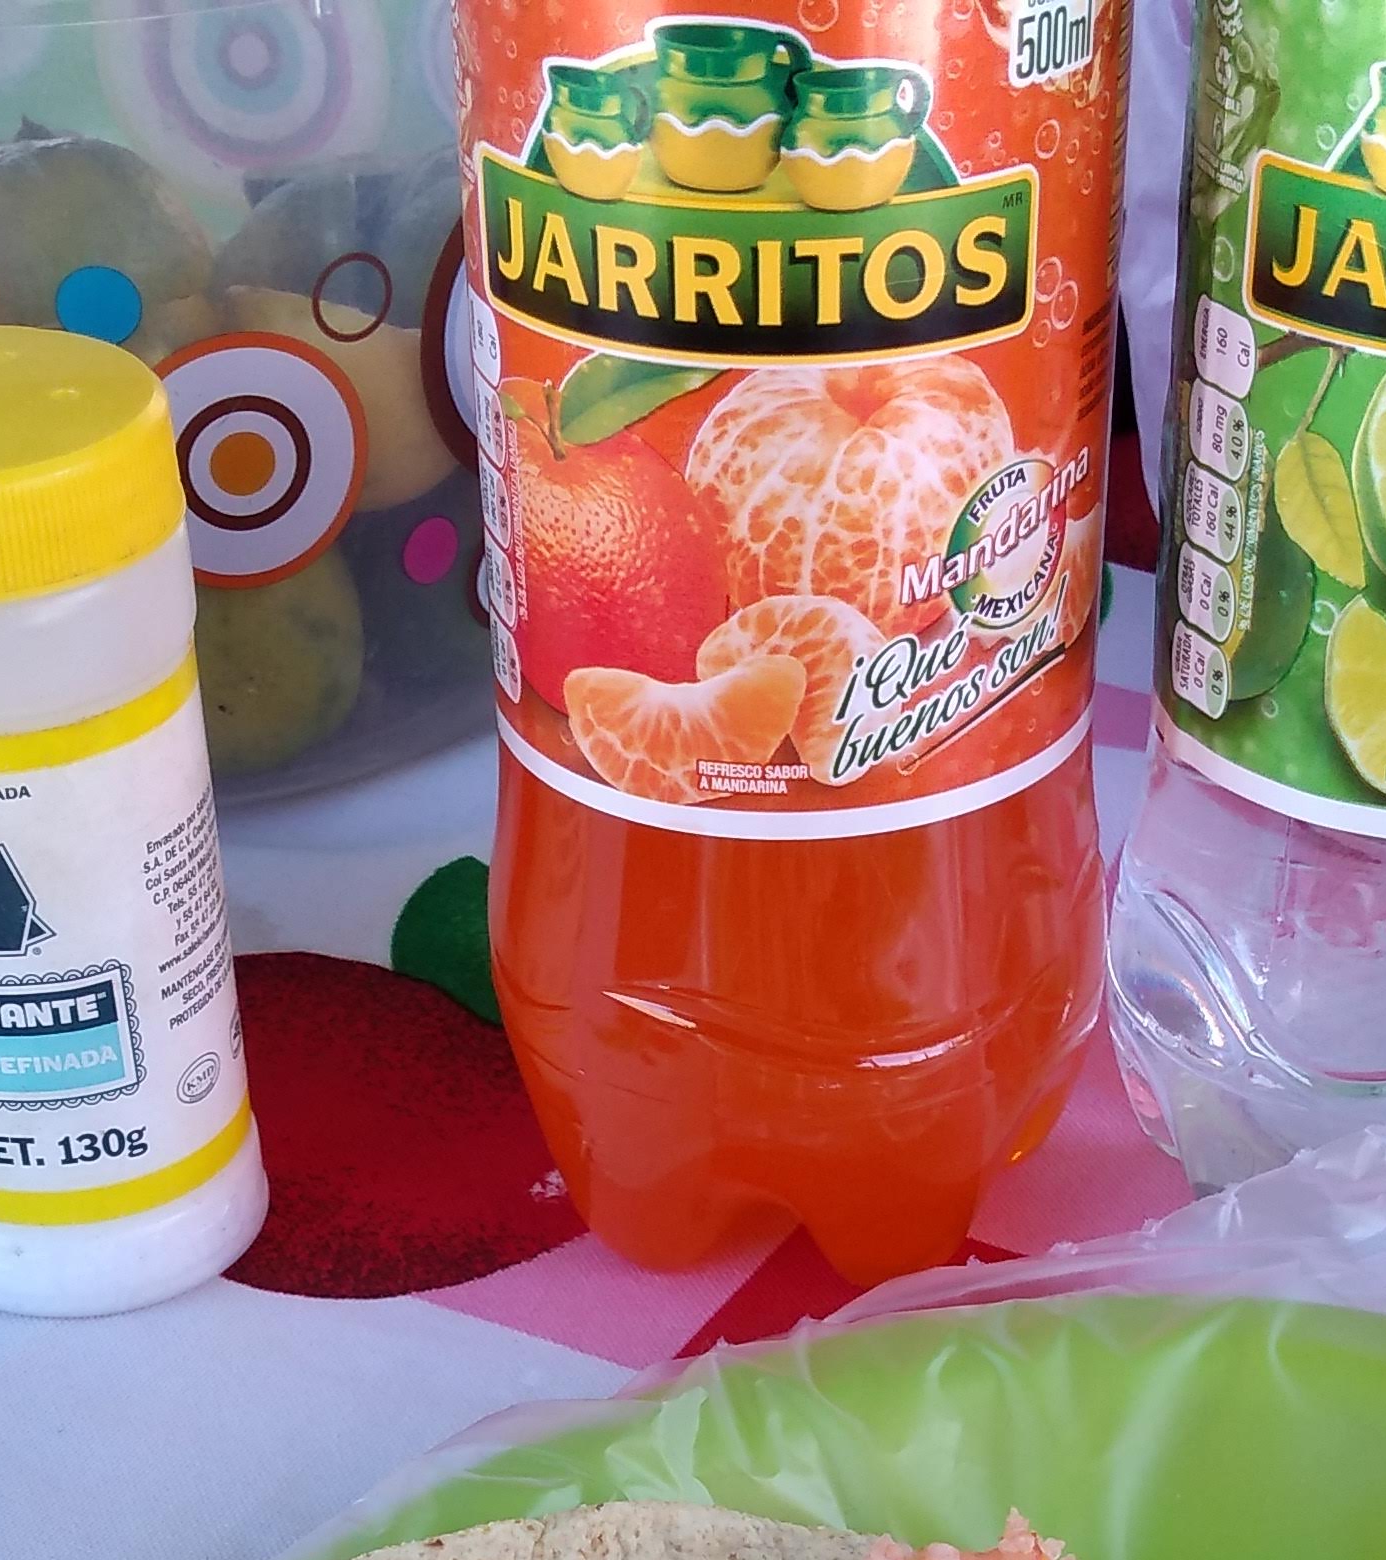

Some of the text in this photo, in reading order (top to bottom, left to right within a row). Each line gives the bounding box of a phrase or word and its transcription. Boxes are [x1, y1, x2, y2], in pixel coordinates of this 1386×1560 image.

[1016, 0, 1093, 79] 500ml
[1002, 191, 1023, 209] MR
[497, 196, 1009, 328] JARRITOS
[1216, 327, 1228, 355] 160
[1237, 341, 1250, 368] Cal
[1212, 404, 1227, 454] 80 mg
[1231, 419, 1244, 460] 4.0 %
[968, 467, 1027, 524] FRUTA
[1205, 482, 1219, 538] 160 Cal
[899, 446, 1089, 605] Mandarina
[1224, 505, 1237, 541] 44 %
[972, 527, 1059, 620] MEXICANA
[1199, 571, 1212, 611] 0 Cal
[1217, 590, 1230, 617] 0 %
[832, 573, 1068, 779] buenos son!
[835, 615, 973, 721] ¡Qué
[1179, 632, 1192, 690] SATURADA
[1194, 651, 1205, 689] 0 Cal
[1211, 668, 1223, 696] 0 %
[698, 761, 808, 779] REFRESCO SABOR
[699, 776, 788, 794] A MANDARINA
[146, 822, 186, 855] Envasado
[143, 857, 164, 875] S.A.
[165, 845, 178, 863] DE
[164, 858, 188, 882] Santa
[153, 886, 172, 905] C.P.
[175, 931, 190, 947] Fax
[169, 986, 215, 1031] PROTEGIDO
[58, 1126, 149, 1166] 130g
